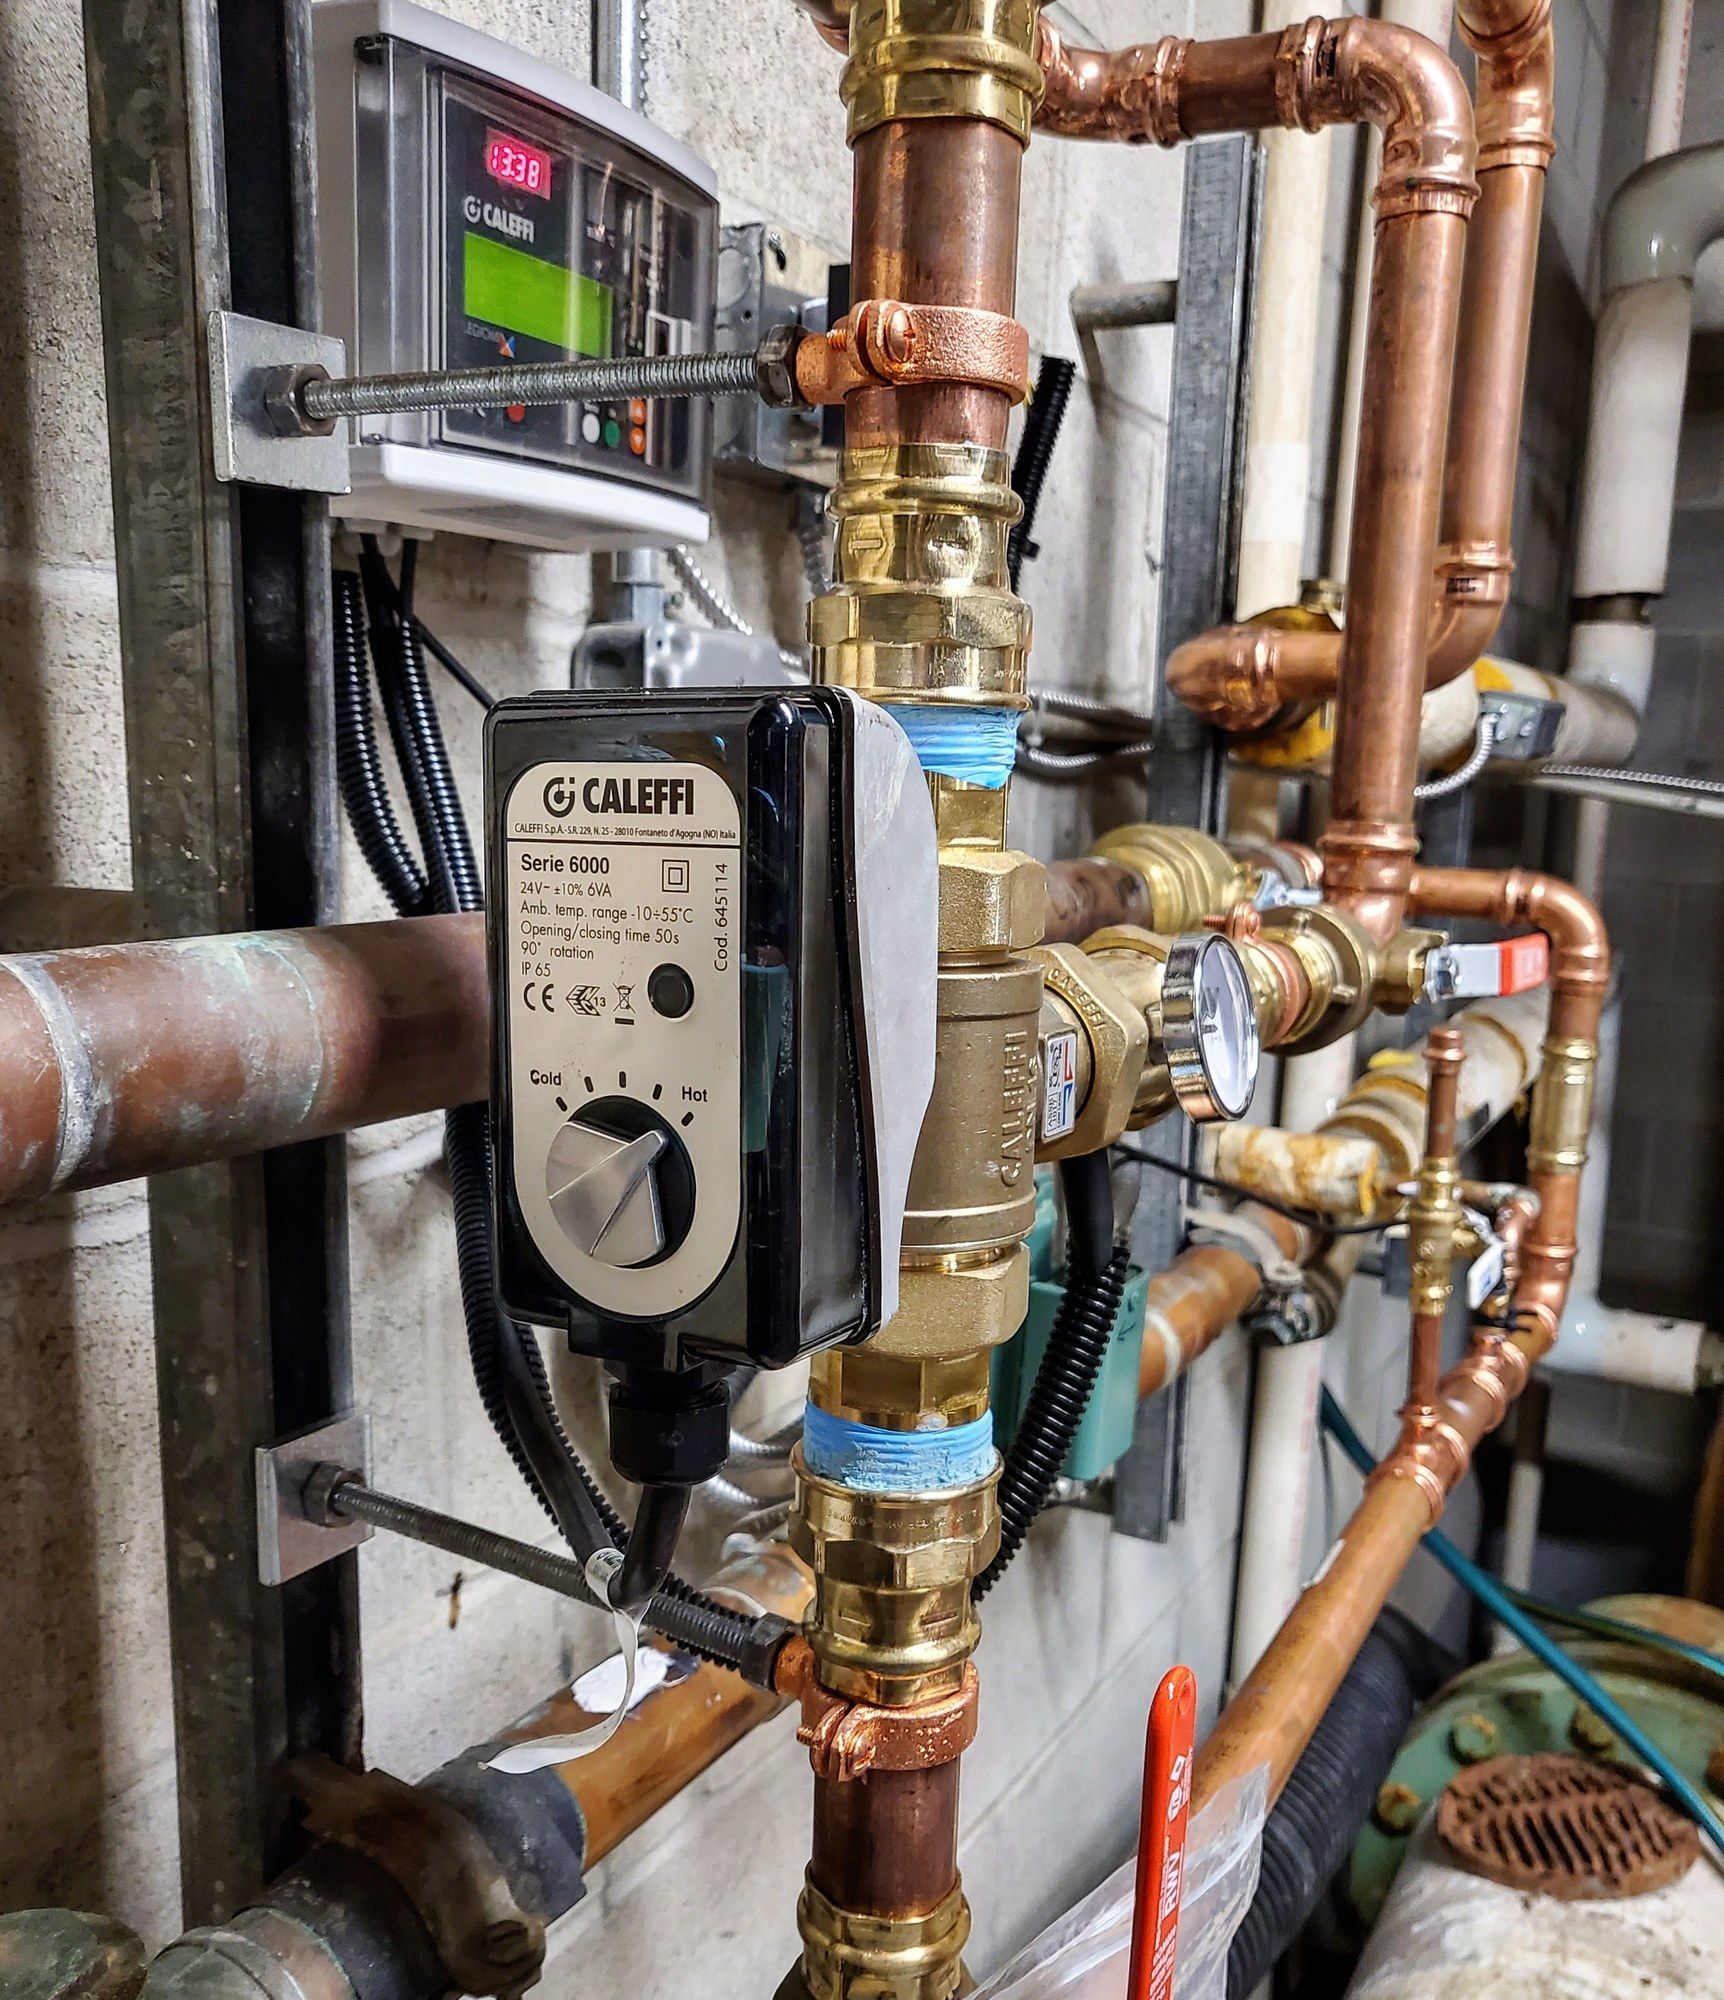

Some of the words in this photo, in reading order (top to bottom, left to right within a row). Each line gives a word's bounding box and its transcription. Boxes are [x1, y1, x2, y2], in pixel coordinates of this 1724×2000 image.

[491, 145, 541, 189] 13:38
[483, 203, 535, 244] CALEFFI
[582, 777, 694, 816] CALEFFI
[514, 822, 543, 833] CALEFFI
[579, 826, 593, 836] 229,
[602, 826, 609, 836] 25
[614, 827, 634, 836] 28010
[634, 828, 668, 838] Fontaneto
[669, 828, 702, 840] d'Agogna
[703, 829, 719, 840] (NO)
[720, 830, 736, 839] Italia
[521, 853, 564, 872] Serie
[569, 855, 610, 874] 6000
[554, 882, 583, 896] ±10%
[587, 882, 612, 898] 6VA
[714, 862, 728, 928] 645114
[520, 899, 551, 915] Amb.
[555, 903, 588, 921] temp.
[592, 908, 628, 923] range
[520, 920, 621, 945] Opening/closing
[625, 927, 650, 942] time
[655, 928, 680, 944] 50s
[521, 940, 542, 956] 90°
[549, 945, 594, 960] rotation
[713, 932, 728, 972] Cod.
[521, 961, 532, 976] IP
[535, 962, 551, 977] 65
[1048, 968, 1106, 1031] CALEFFI
[530, 1069, 562, 1086] Cold
[681, 1086, 708, 1103] Hot
[1000, 1028, 1029, 1188] CALEFFI
